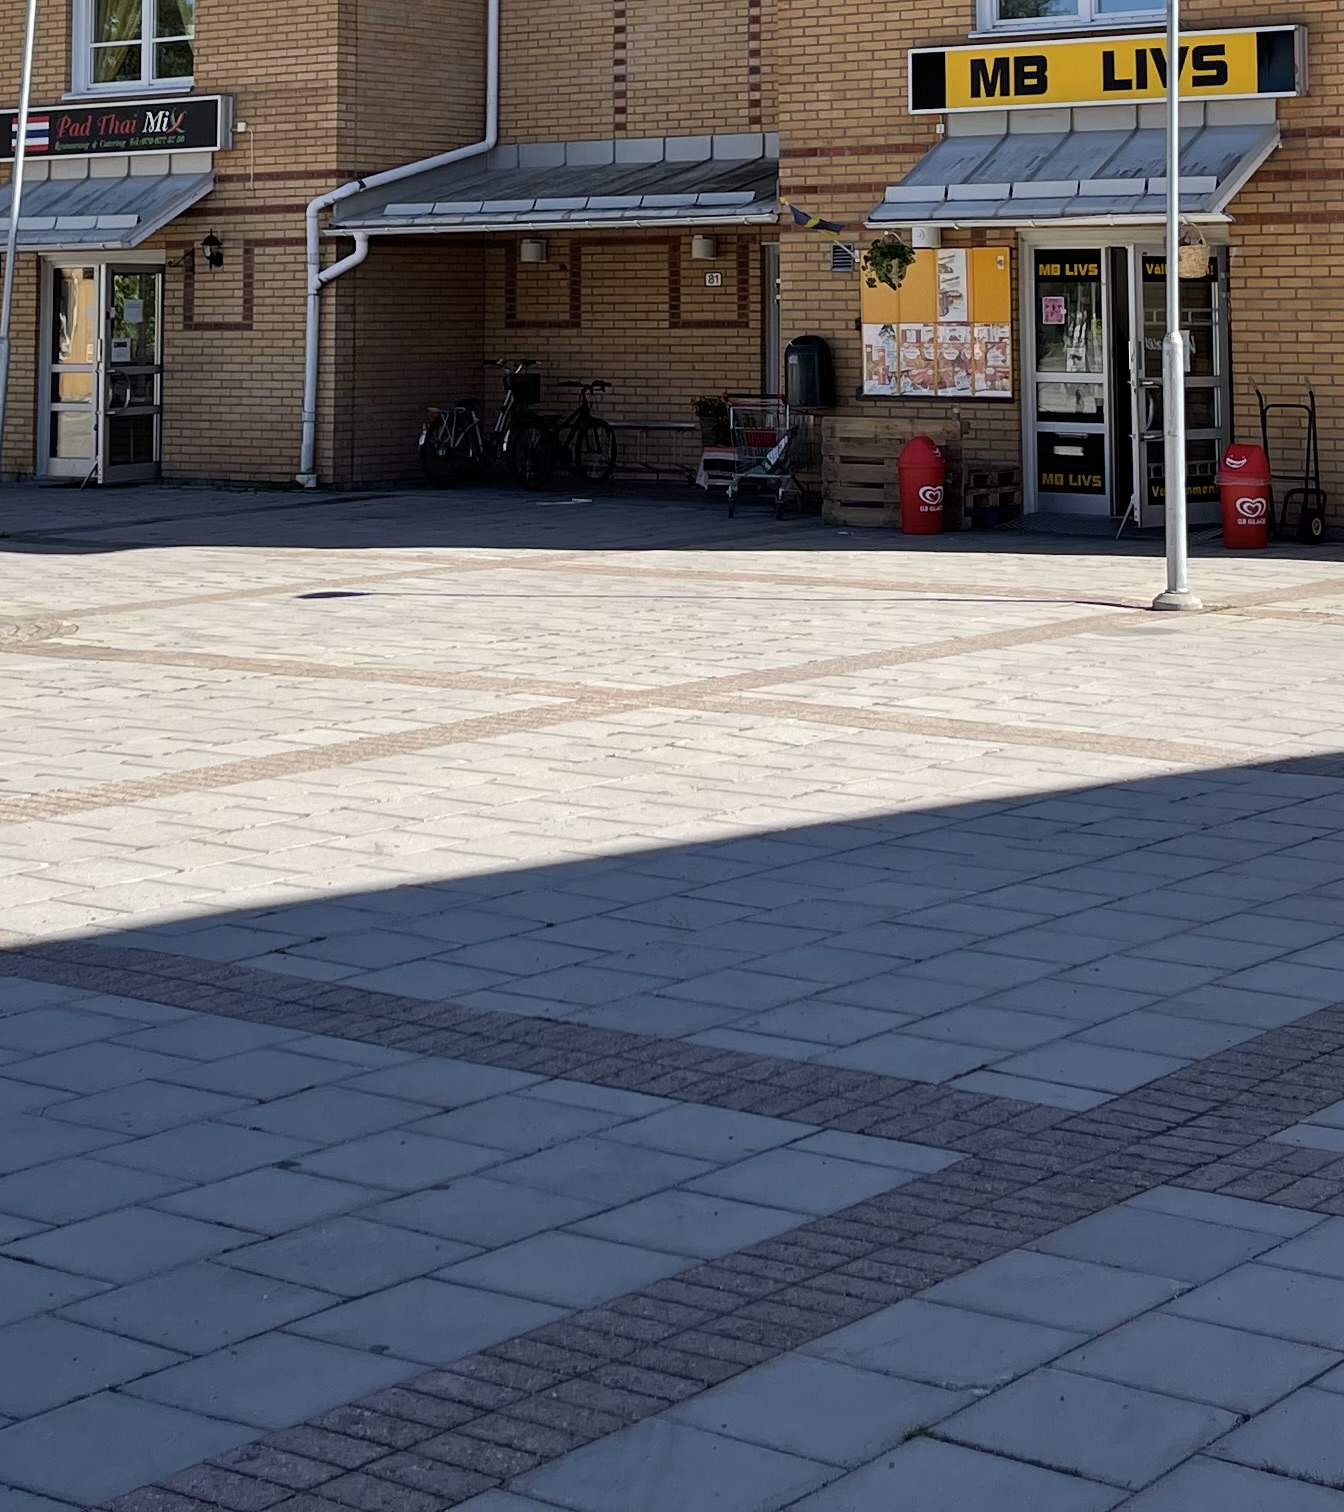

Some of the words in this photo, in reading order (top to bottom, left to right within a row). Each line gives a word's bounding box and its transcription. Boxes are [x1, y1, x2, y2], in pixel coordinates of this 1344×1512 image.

[970, 55, 1048, 98] MB
[1102, 44, 1228, 92] LIVS
[57, 114, 93, 138] Pad
[96, 113, 138, 136] Thai
[1039, 264, 1060, 276] MB
[1065, 263, 1098, 276] LIVS
[708, 274, 719, 284] 81
[1042, 473, 1064, 486] MB
[1069, 474, 1102, 487] LIVS
